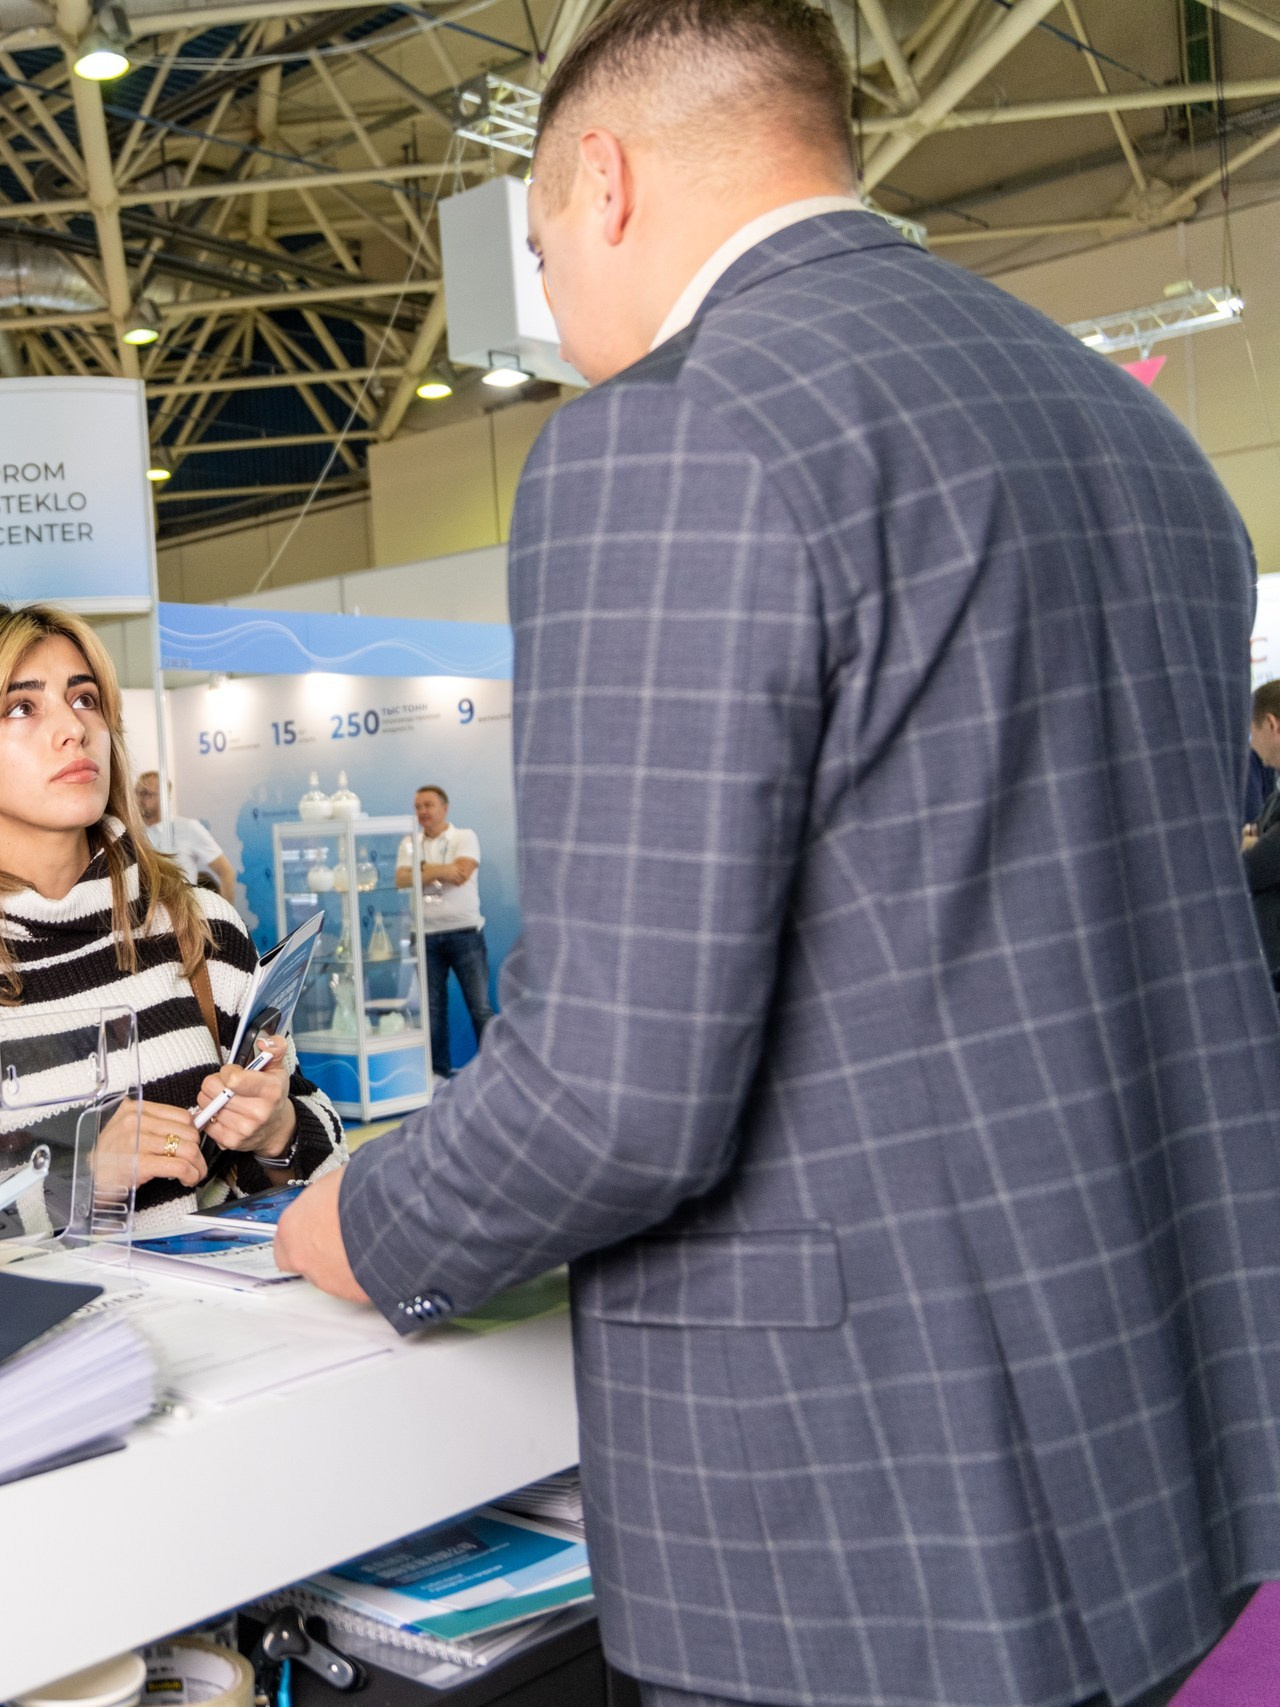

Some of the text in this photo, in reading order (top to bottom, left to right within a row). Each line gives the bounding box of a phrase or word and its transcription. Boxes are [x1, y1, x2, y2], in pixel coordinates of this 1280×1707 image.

[458, 698, 475, 724] 9
[271, 720, 297, 745] 15
[330, 709, 380, 739] 250
[199, 731, 227, 754] 50
